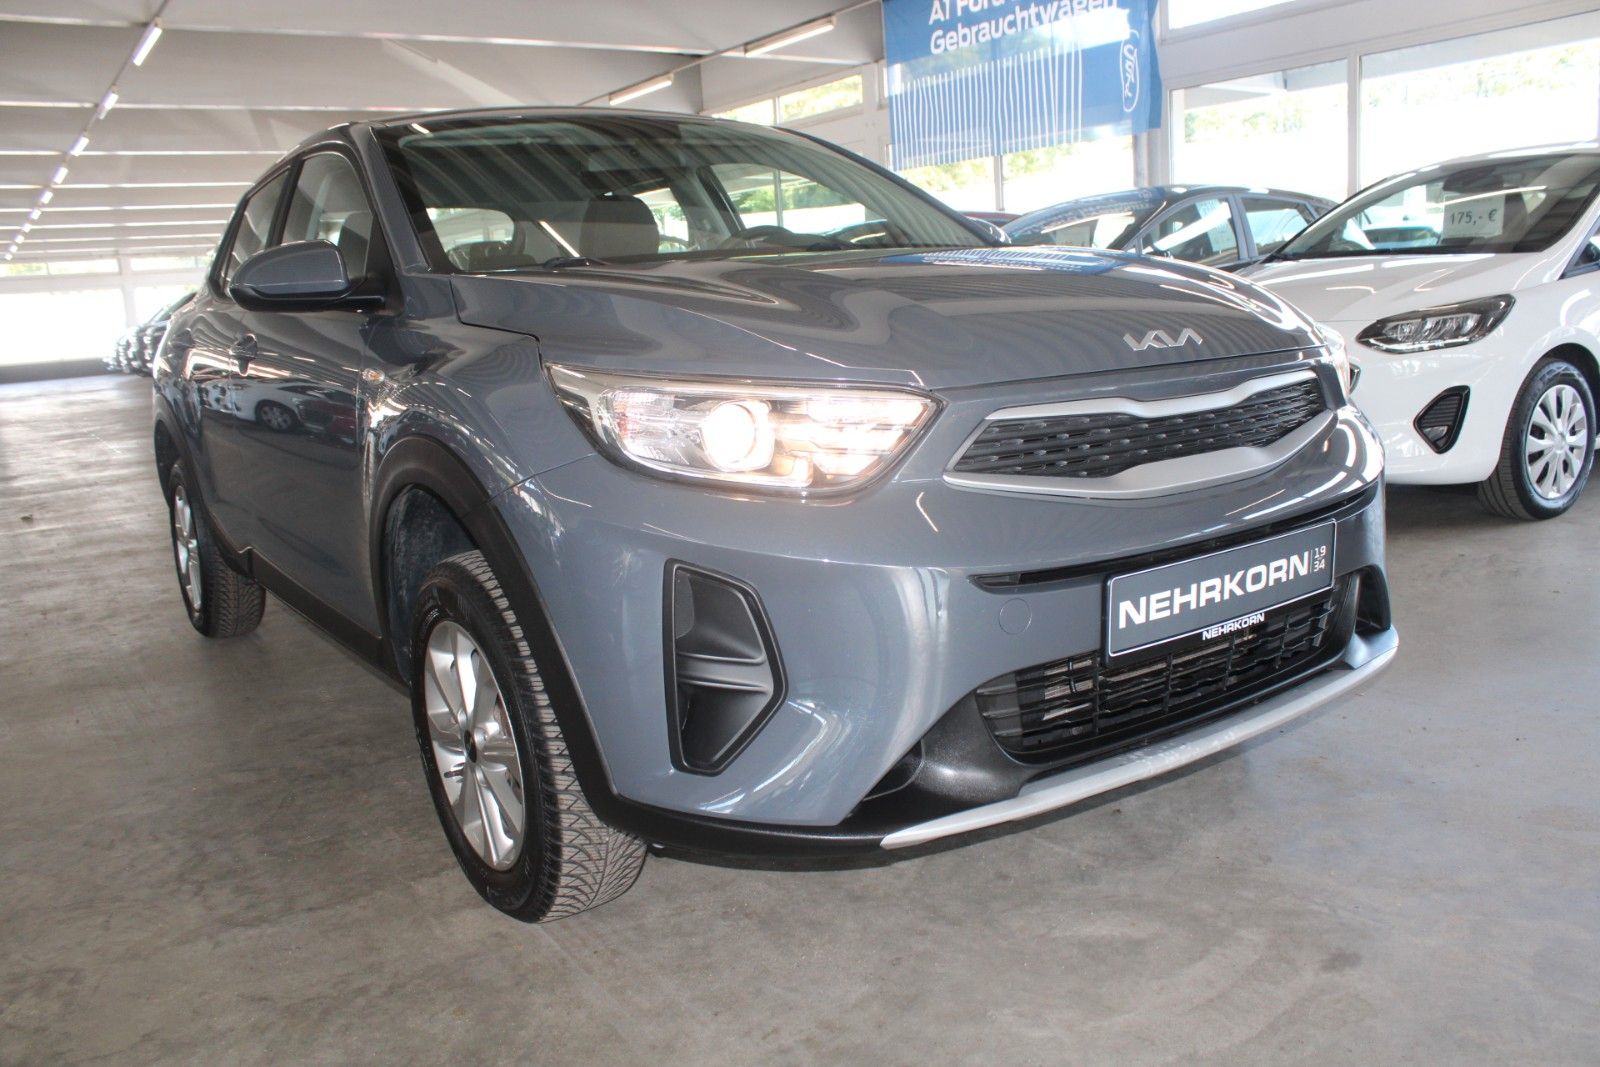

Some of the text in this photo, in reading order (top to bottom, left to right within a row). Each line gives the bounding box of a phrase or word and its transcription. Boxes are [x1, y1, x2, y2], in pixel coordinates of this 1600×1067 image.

[957, 0, 1006, 17] For
[1314, 545, 1327, 559] 19
[1313, 558, 1326, 572] 34
[1118, 550, 1309, 630] NEHRKORN
[1202, 611, 1265, 641] NEHRKORN
